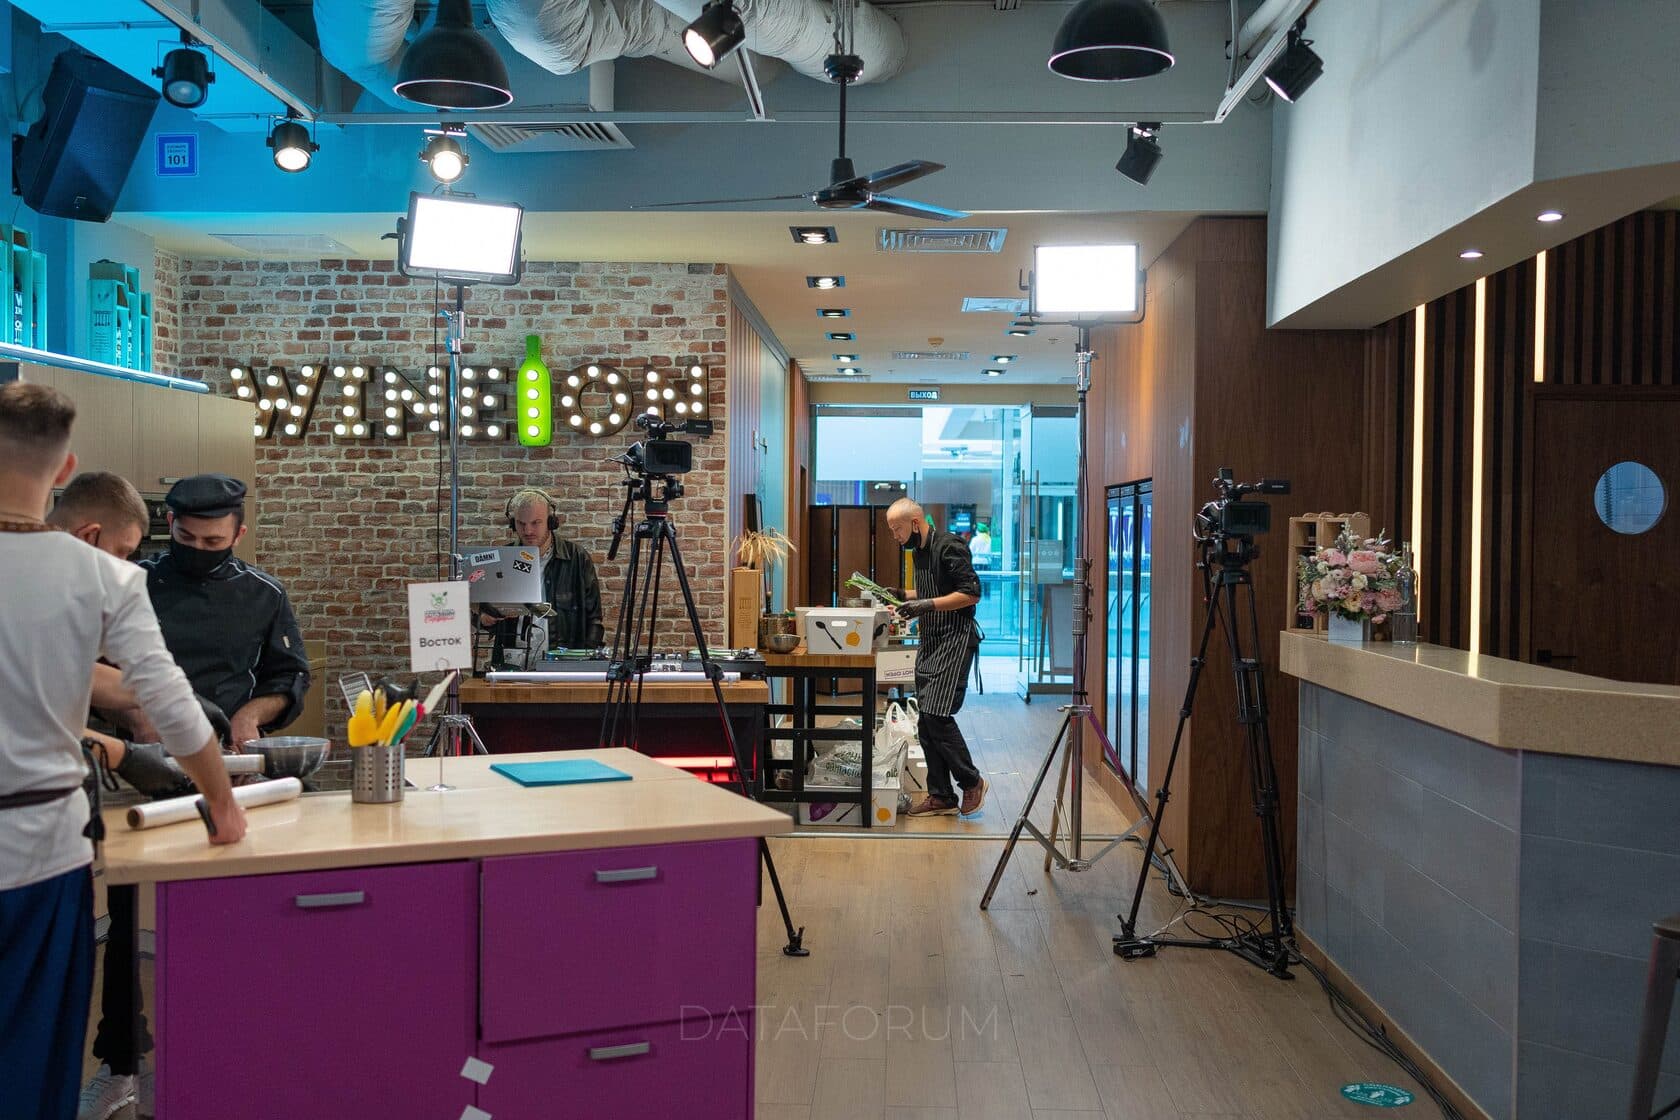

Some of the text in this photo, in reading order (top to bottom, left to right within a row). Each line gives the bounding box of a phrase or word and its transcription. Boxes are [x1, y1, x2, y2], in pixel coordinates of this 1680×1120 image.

[168, 155, 186, 165] 101
[910, 391, 938, 400] ВЫХОД
[227, 362, 709, 440] WINE ON
[475, 552, 495, 563] DAMN!
